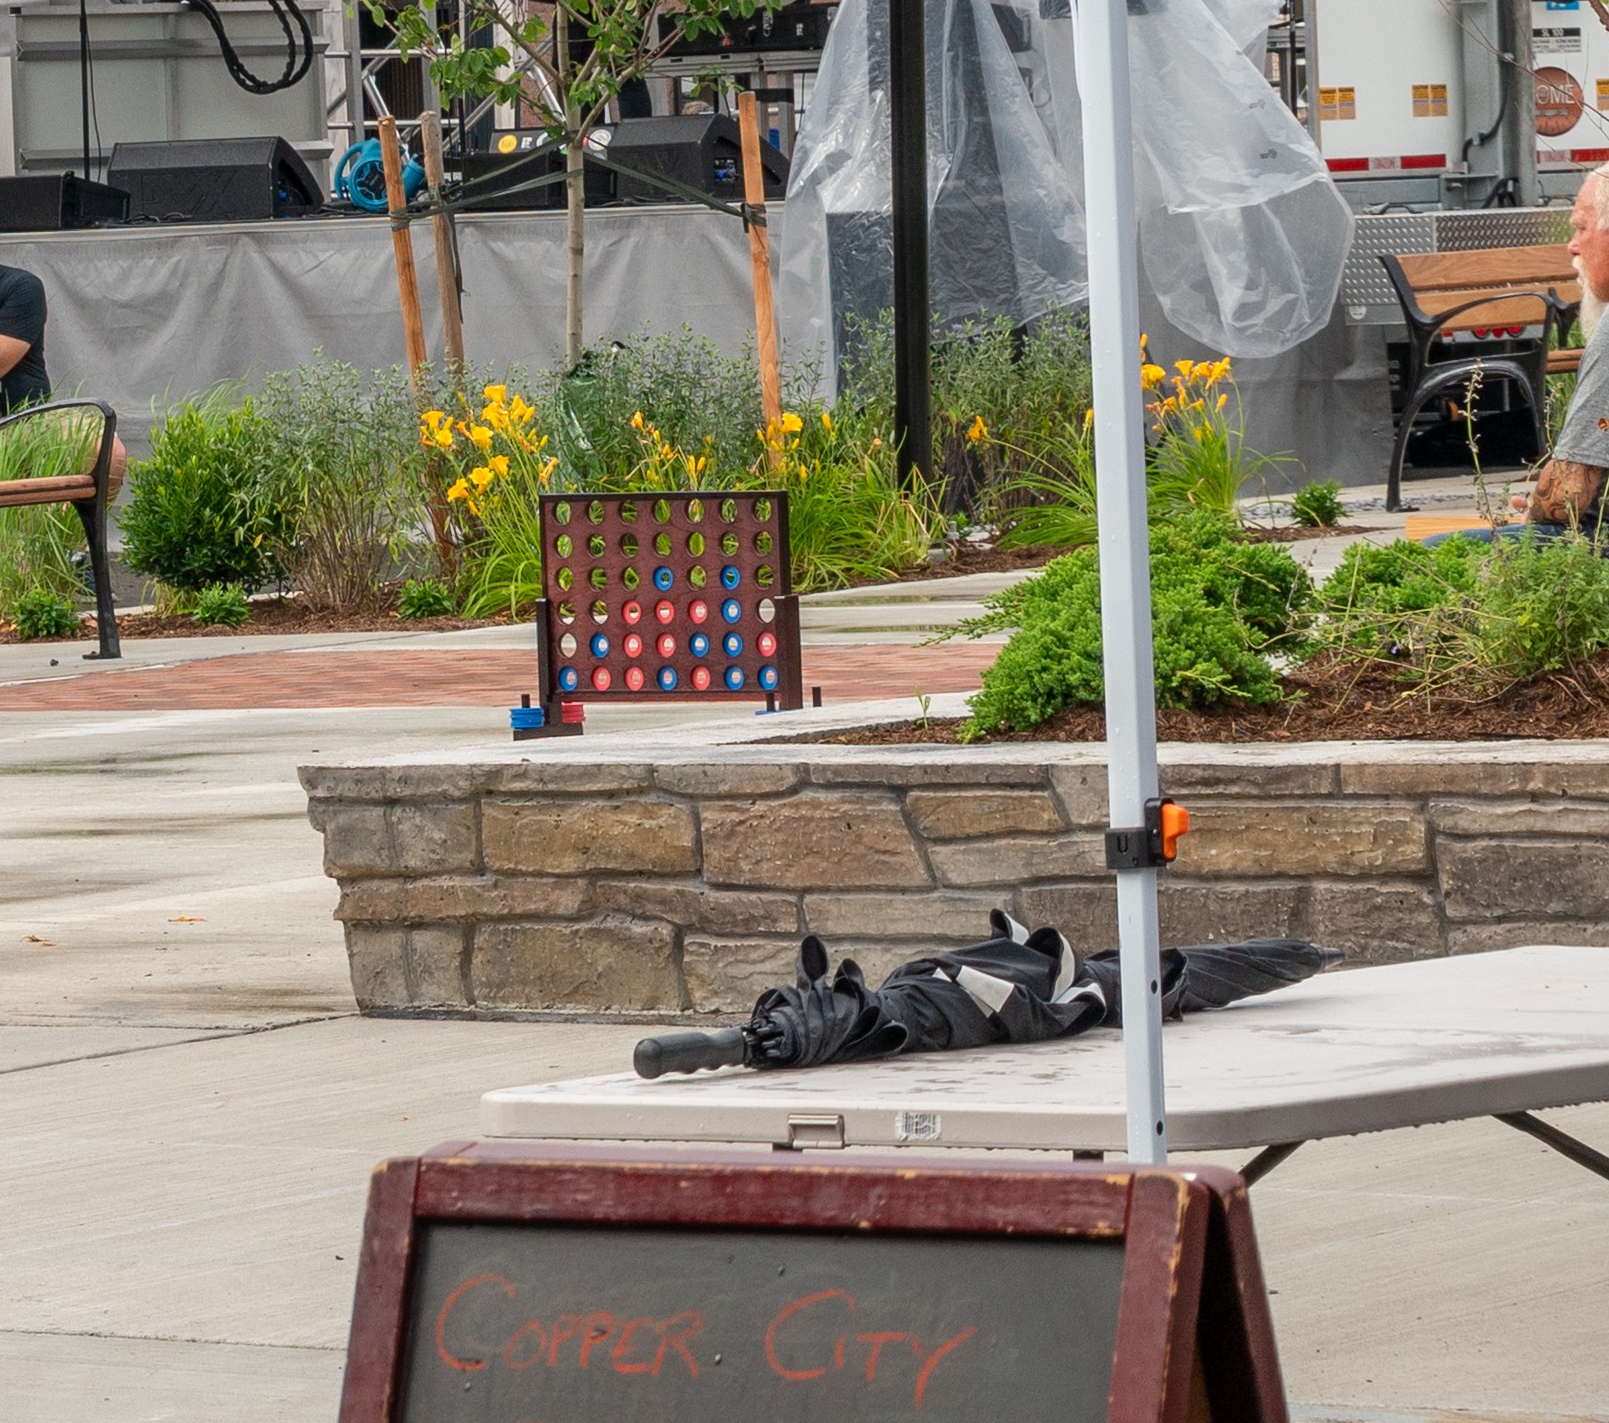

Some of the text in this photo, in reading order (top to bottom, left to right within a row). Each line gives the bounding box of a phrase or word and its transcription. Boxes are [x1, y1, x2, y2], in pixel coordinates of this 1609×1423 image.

[1534, 83, 1576, 106] OME
[434, 1273, 979, 1409] COPPER CITY
